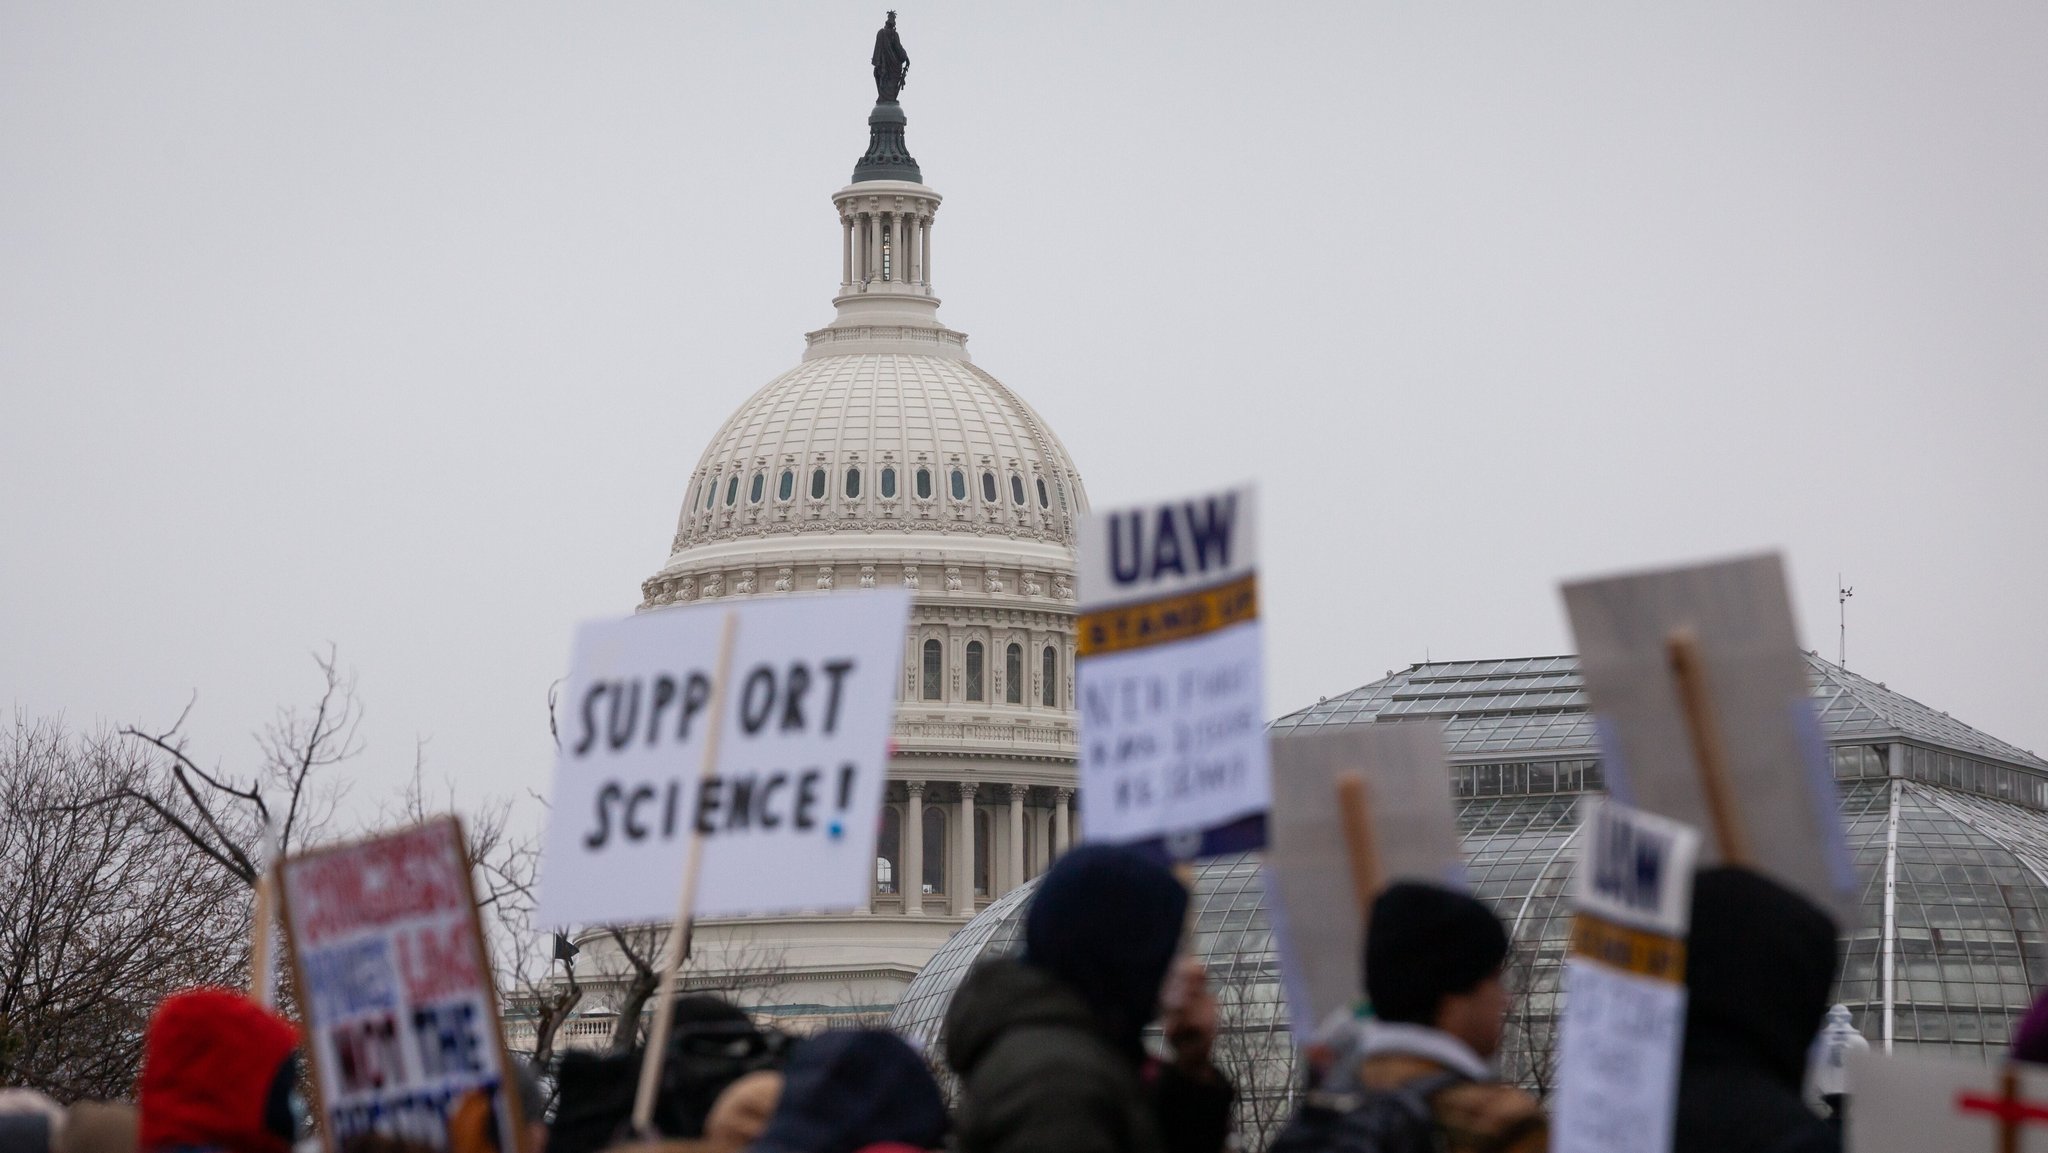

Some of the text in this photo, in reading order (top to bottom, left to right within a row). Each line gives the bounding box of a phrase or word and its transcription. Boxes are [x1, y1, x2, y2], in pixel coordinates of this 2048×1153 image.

[1107, 489, 1239, 585] UAW
[1090, 603, 1209, 646] STAND
[573, 655, 857, 757] SUPPORT
[582, 761, 859, 852] SCIENCE!
